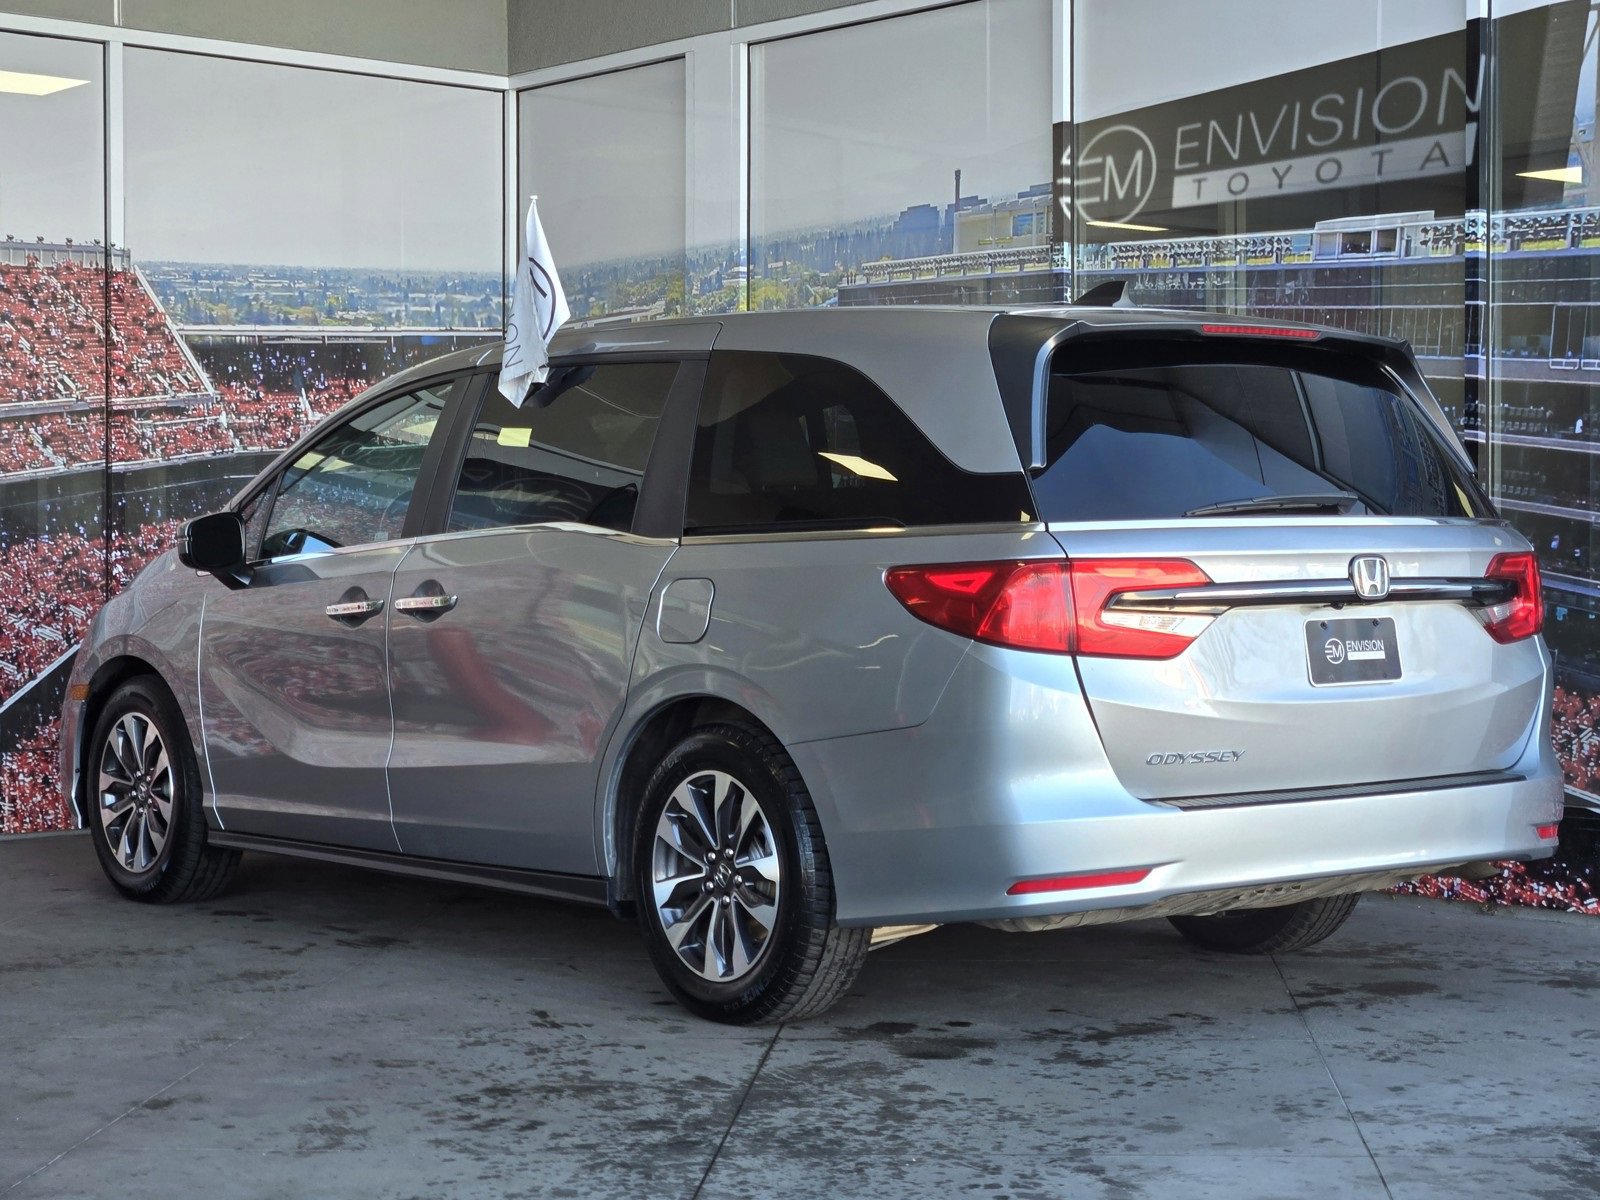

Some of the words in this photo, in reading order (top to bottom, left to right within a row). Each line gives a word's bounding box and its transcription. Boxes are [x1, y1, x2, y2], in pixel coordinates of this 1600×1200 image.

[1174, 54, 1486, 171] ENVISION
[1192, 140, 1450, 199] TOYOTA
[1345, 639, 1385, 653] ENVISION
[1145, 749, 1246, 766] ODYSSEY
